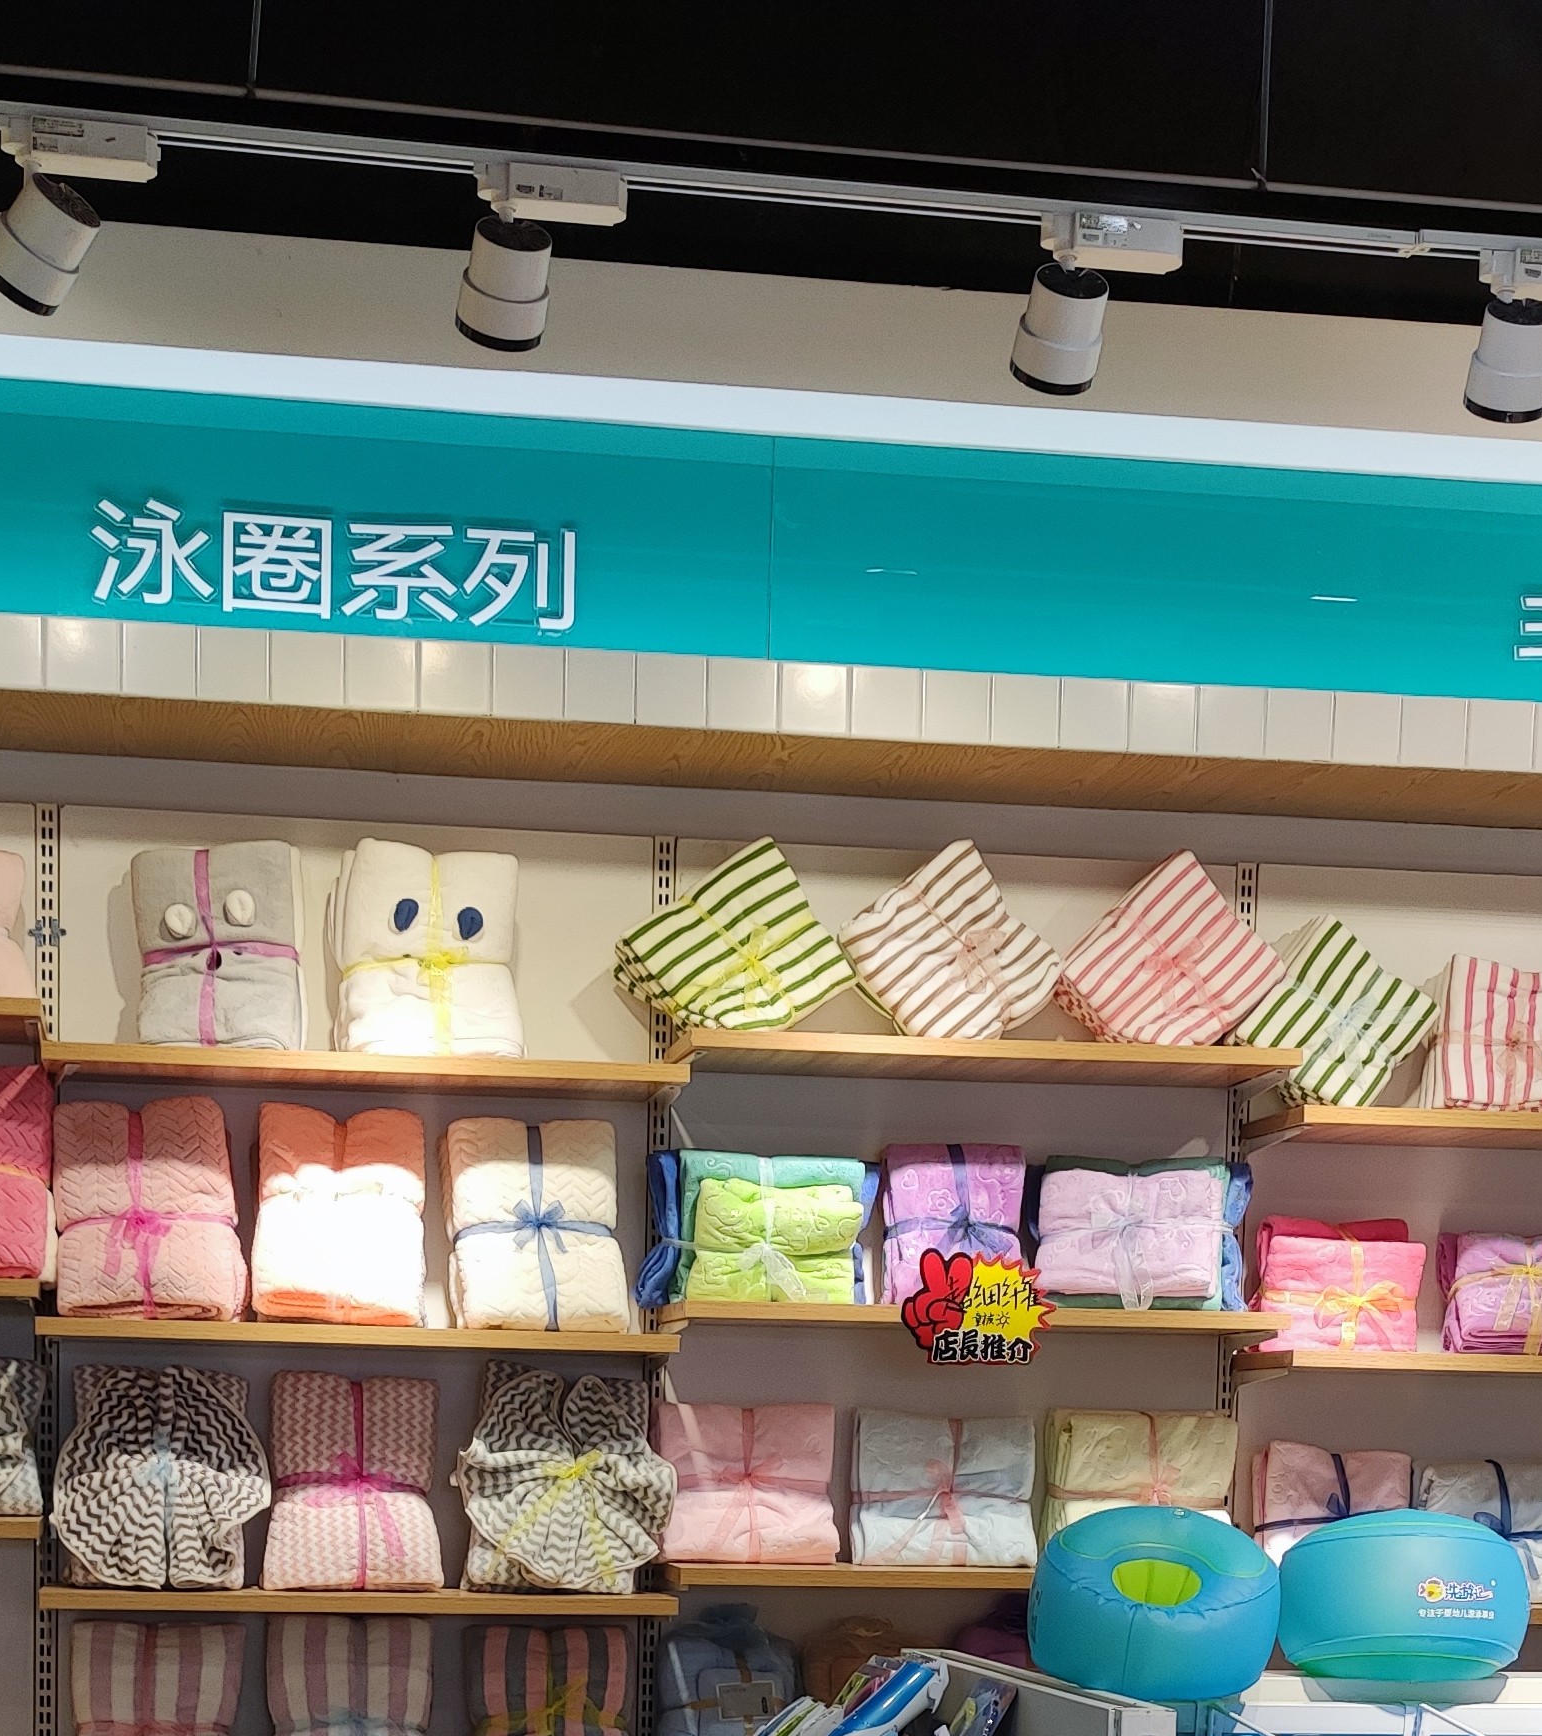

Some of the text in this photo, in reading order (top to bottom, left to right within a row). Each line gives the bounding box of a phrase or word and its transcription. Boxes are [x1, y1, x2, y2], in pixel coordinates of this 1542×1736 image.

[91, 498, 576, 630] 泳圈系列
[943, 1276, 1042, 1315] 超细纤维
